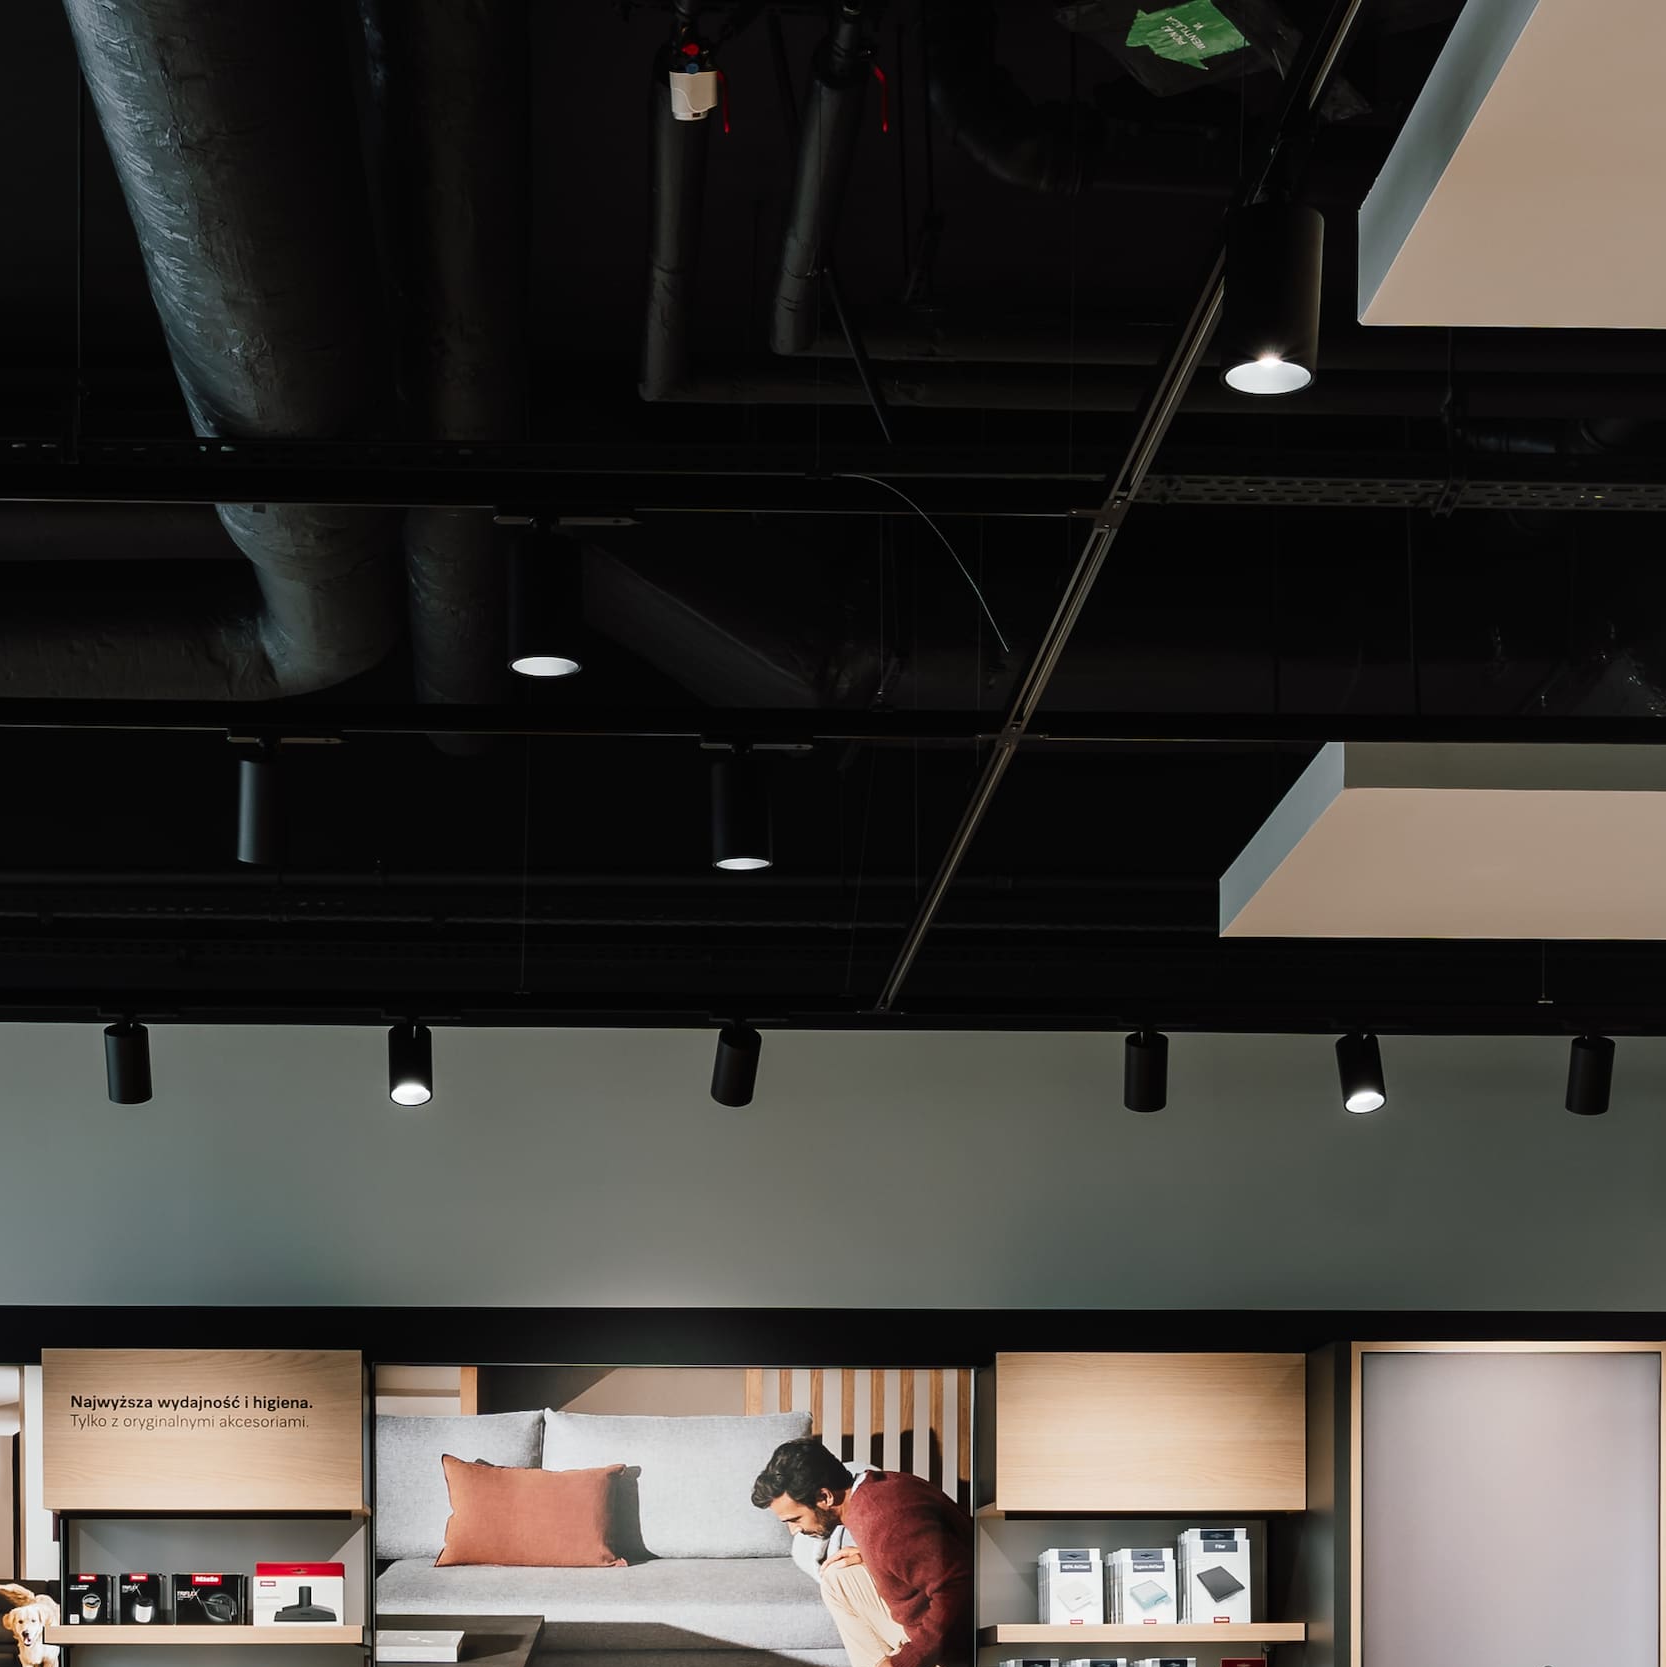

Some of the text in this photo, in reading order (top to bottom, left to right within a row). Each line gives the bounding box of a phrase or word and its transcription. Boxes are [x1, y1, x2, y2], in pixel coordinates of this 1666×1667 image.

[71, 1395, 313, 1411] Najwyższa wydajność i higiena.
[71, 1415, 309, 1431] Tylko z oryginalnymi akcesoriami.
